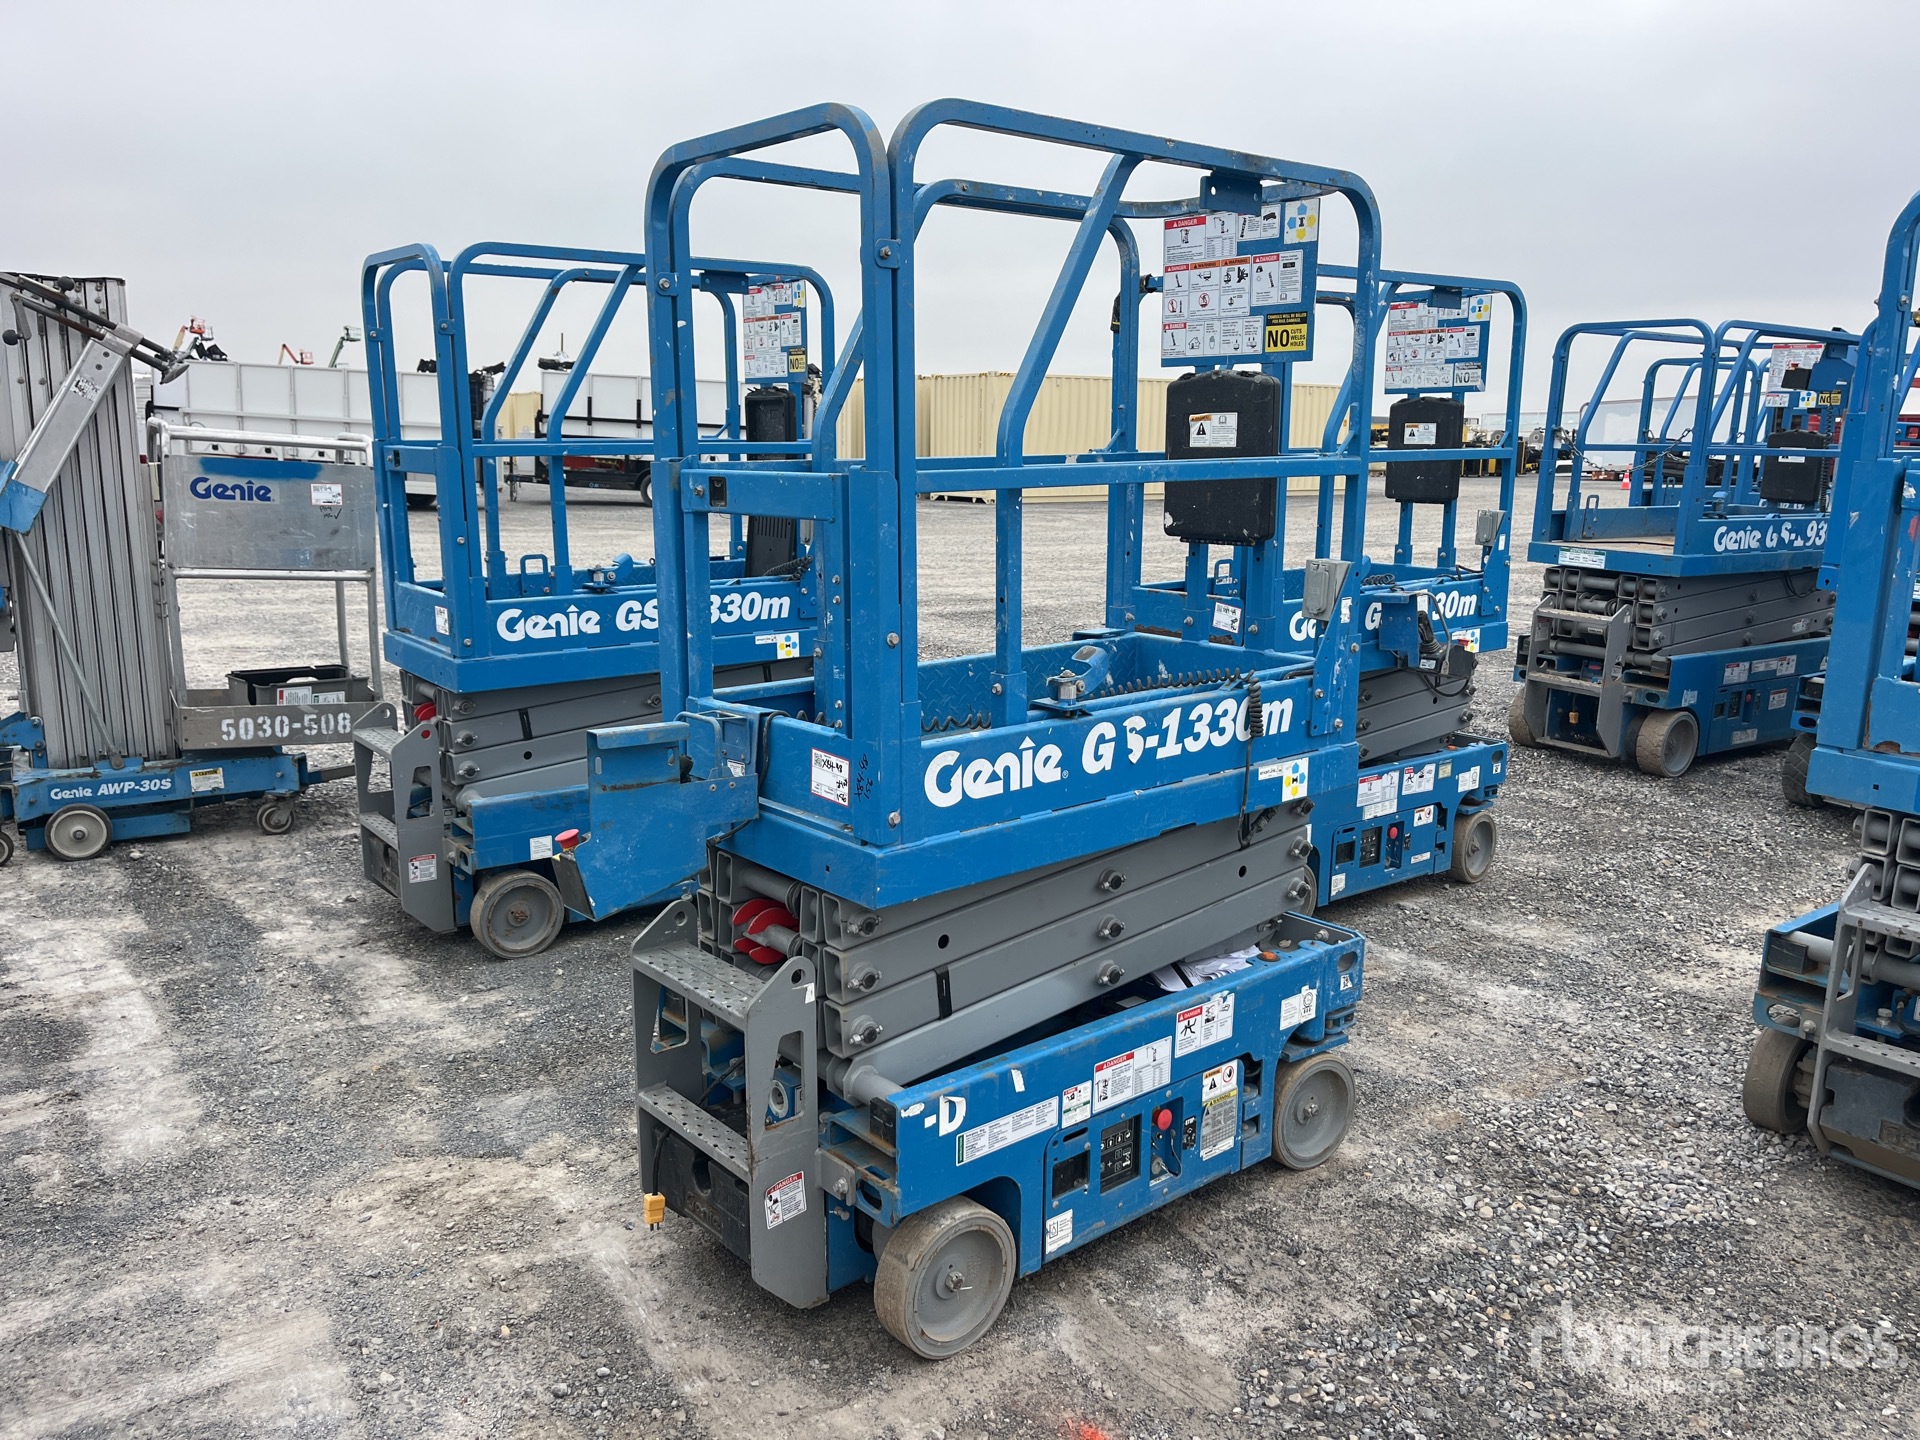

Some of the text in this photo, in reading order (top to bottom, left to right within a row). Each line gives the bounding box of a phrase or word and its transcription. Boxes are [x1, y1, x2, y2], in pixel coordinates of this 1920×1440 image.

[1178, 219, 1198, 227] DANGER
[1267, 329, 1290, 348] NO
[790, 358, 799, 370] NO
[1456, 372, 1470, 384] NO
[190, 476, 271, 502] Genie
[1714, 525, 1761, 552] Genie
[496, 604, 600, 642] Genie
[221, 712, 351, 741] 5030-508
[924, 736, 1062, 808] Genie
[50, 778, 172, 800] Genie AWP-30S
[1184, 1008, 1201, 1019] DANGER
[1106, 1056, 1127, 1068] DANGER
[1213, 1093, 1231, 1104] WARNING
[1185, 1117, 1195, 1126] STOP
[776, 1175, 798, 1192] DANGER
